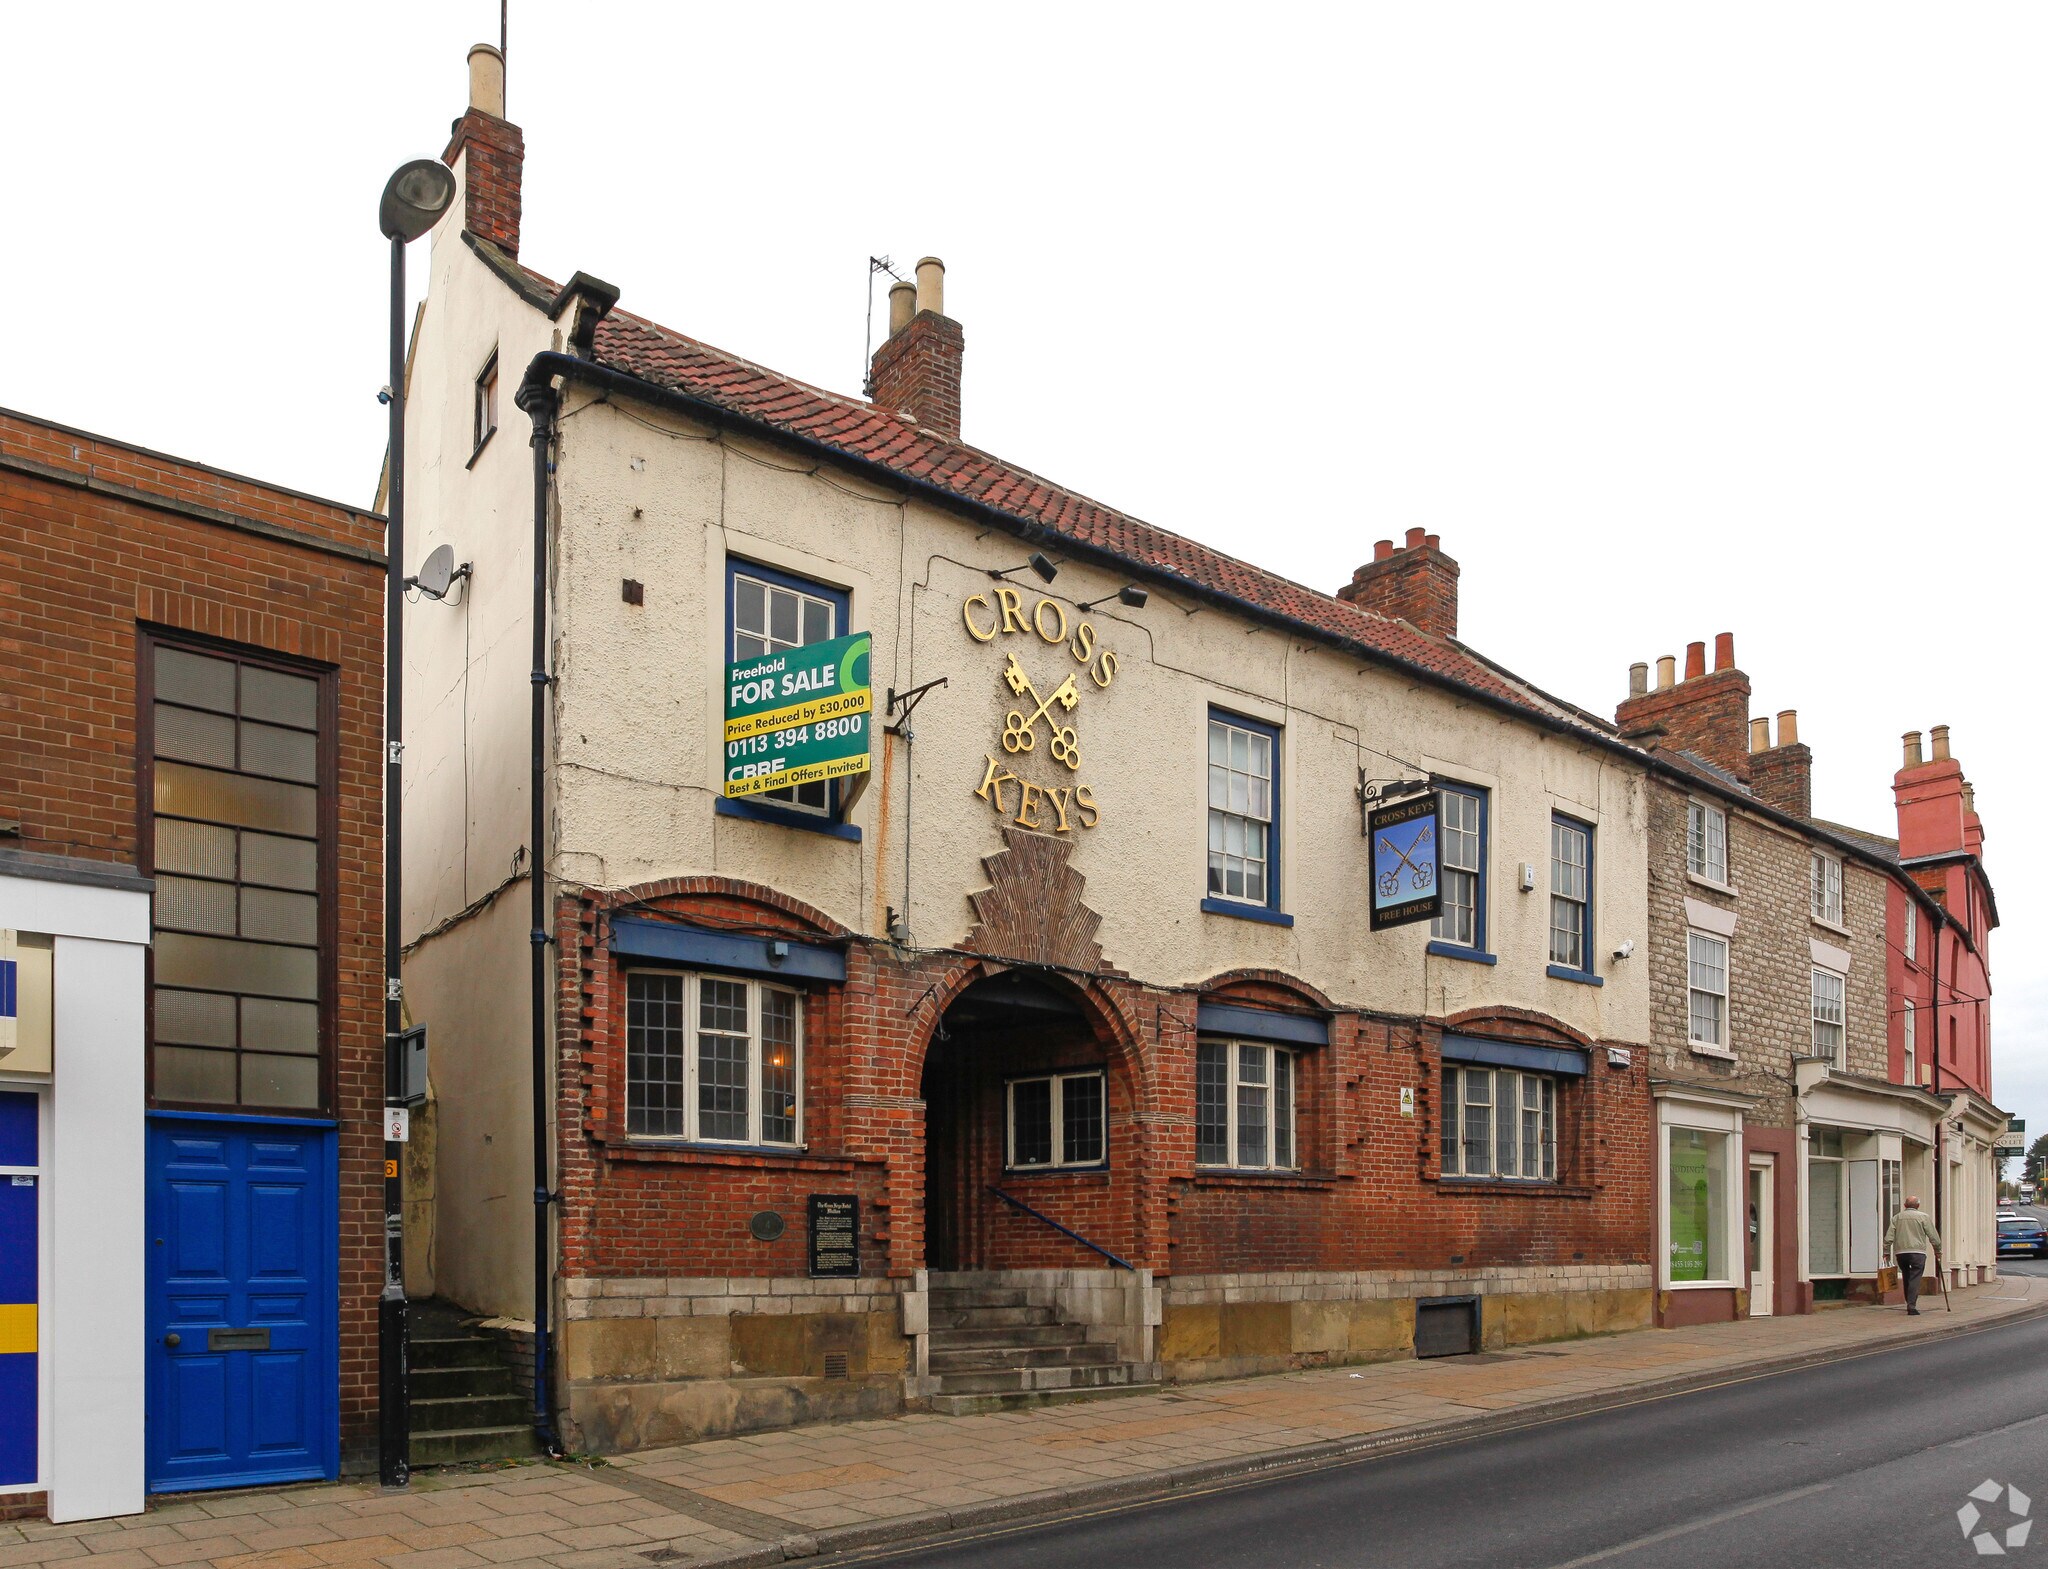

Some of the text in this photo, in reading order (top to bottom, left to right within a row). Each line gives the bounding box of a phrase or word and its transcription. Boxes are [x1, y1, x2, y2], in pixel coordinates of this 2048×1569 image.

[962, 588, 1120, 688] CROSS
[731, 664, 835, 707] FOR SALE
[732, 658, 785, 681] Freehold
[727, 695, 865, 735] Price Reduced by £30,000
[728, 714, 862, 758] 0113 394 8800
[728, 757, 786, 782] CBRE
[729, 758, 863, 795] Best & Final Offers Invited
[974, 754, 1100, 832] KEYS
[1374, 801, 1435, 826] CROSS KEYS
[1379, 901, 1433, 922] FREE HOUSE
